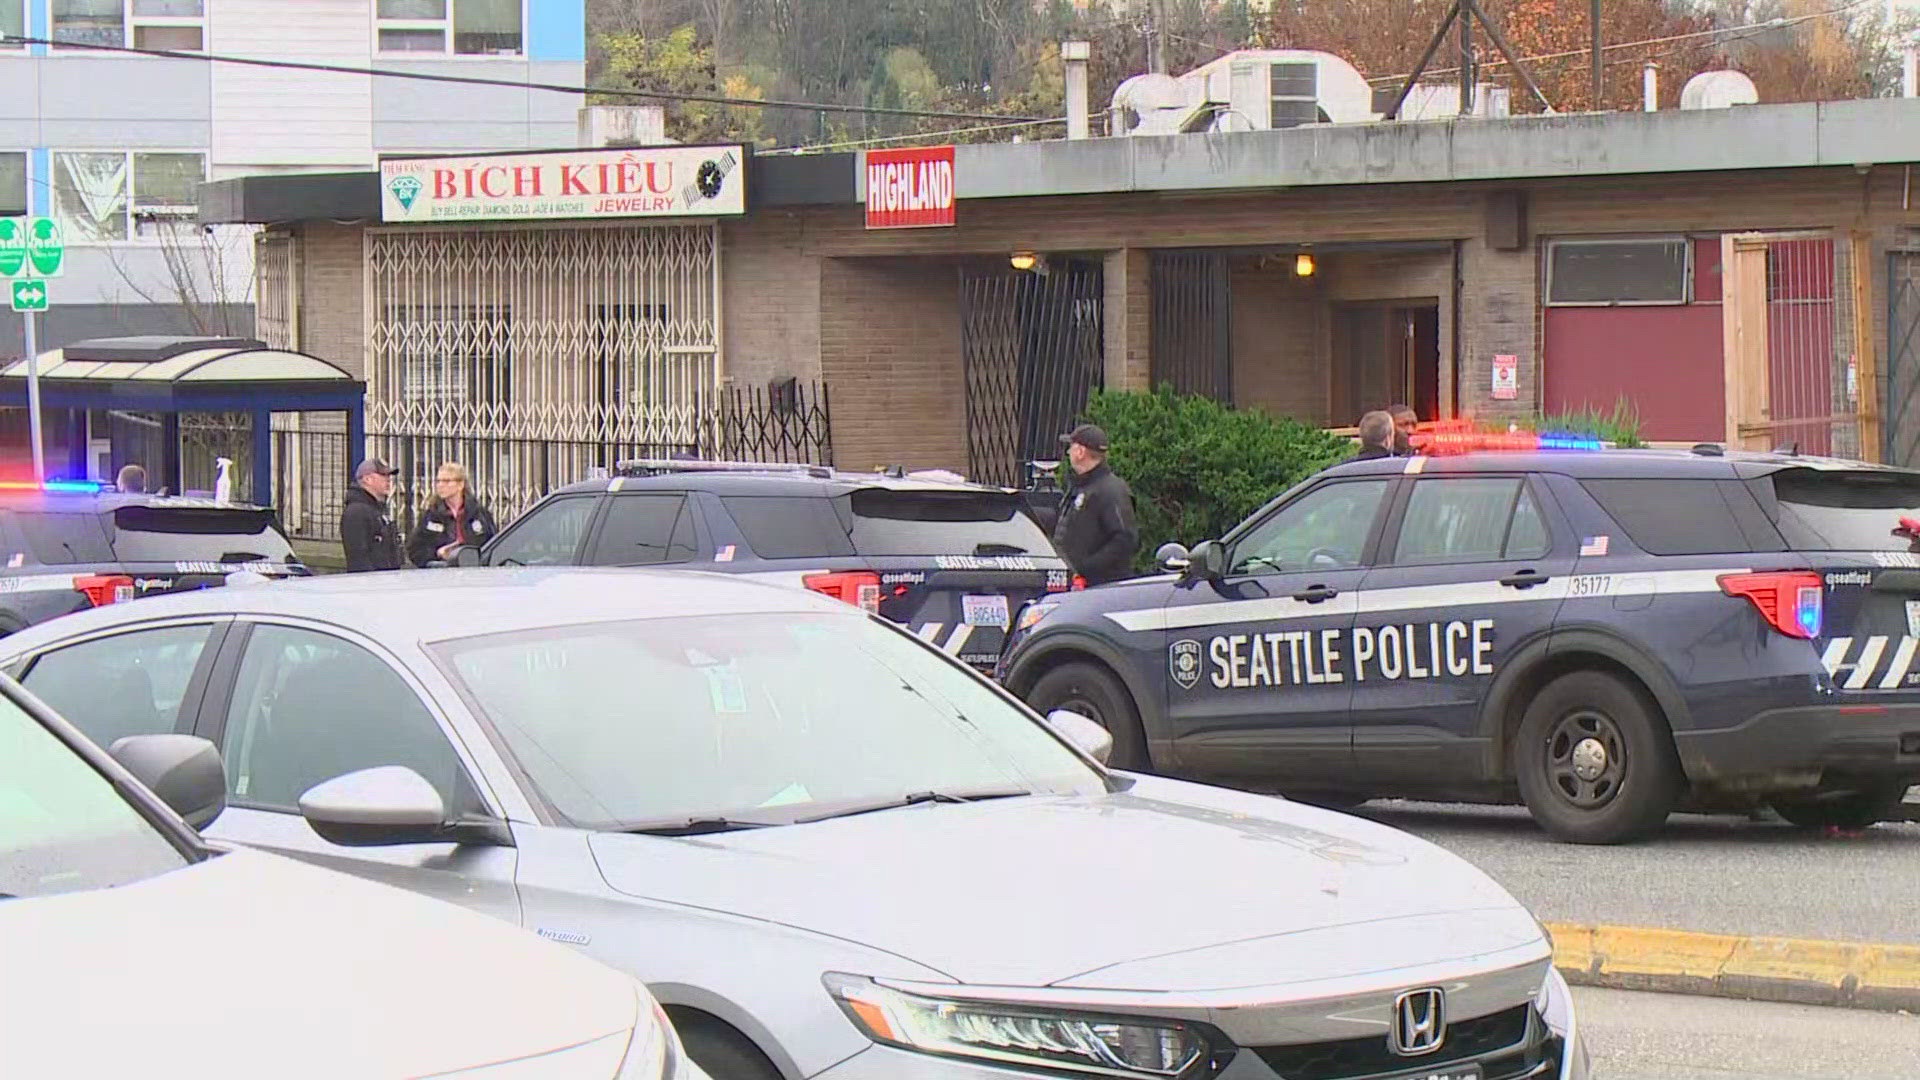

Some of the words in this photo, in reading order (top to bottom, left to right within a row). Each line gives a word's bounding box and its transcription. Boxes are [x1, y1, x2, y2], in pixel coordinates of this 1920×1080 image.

[432, 163, 543, 199] BÍCH
[561, 152, 675, 197] KIỀU
[868, 160, 952, 212] HIGHLAND
[595, 197, 674, 213] JEWELRY
[935, 555, 980, 569] SEATTLE
[996, 556, 1037, 570] POLICE
[1572, 575, 1611, 595] 35177
[1208, 629, 1344, 689] SEATTLE
[1353, 619, 1493, 681] POLICE
